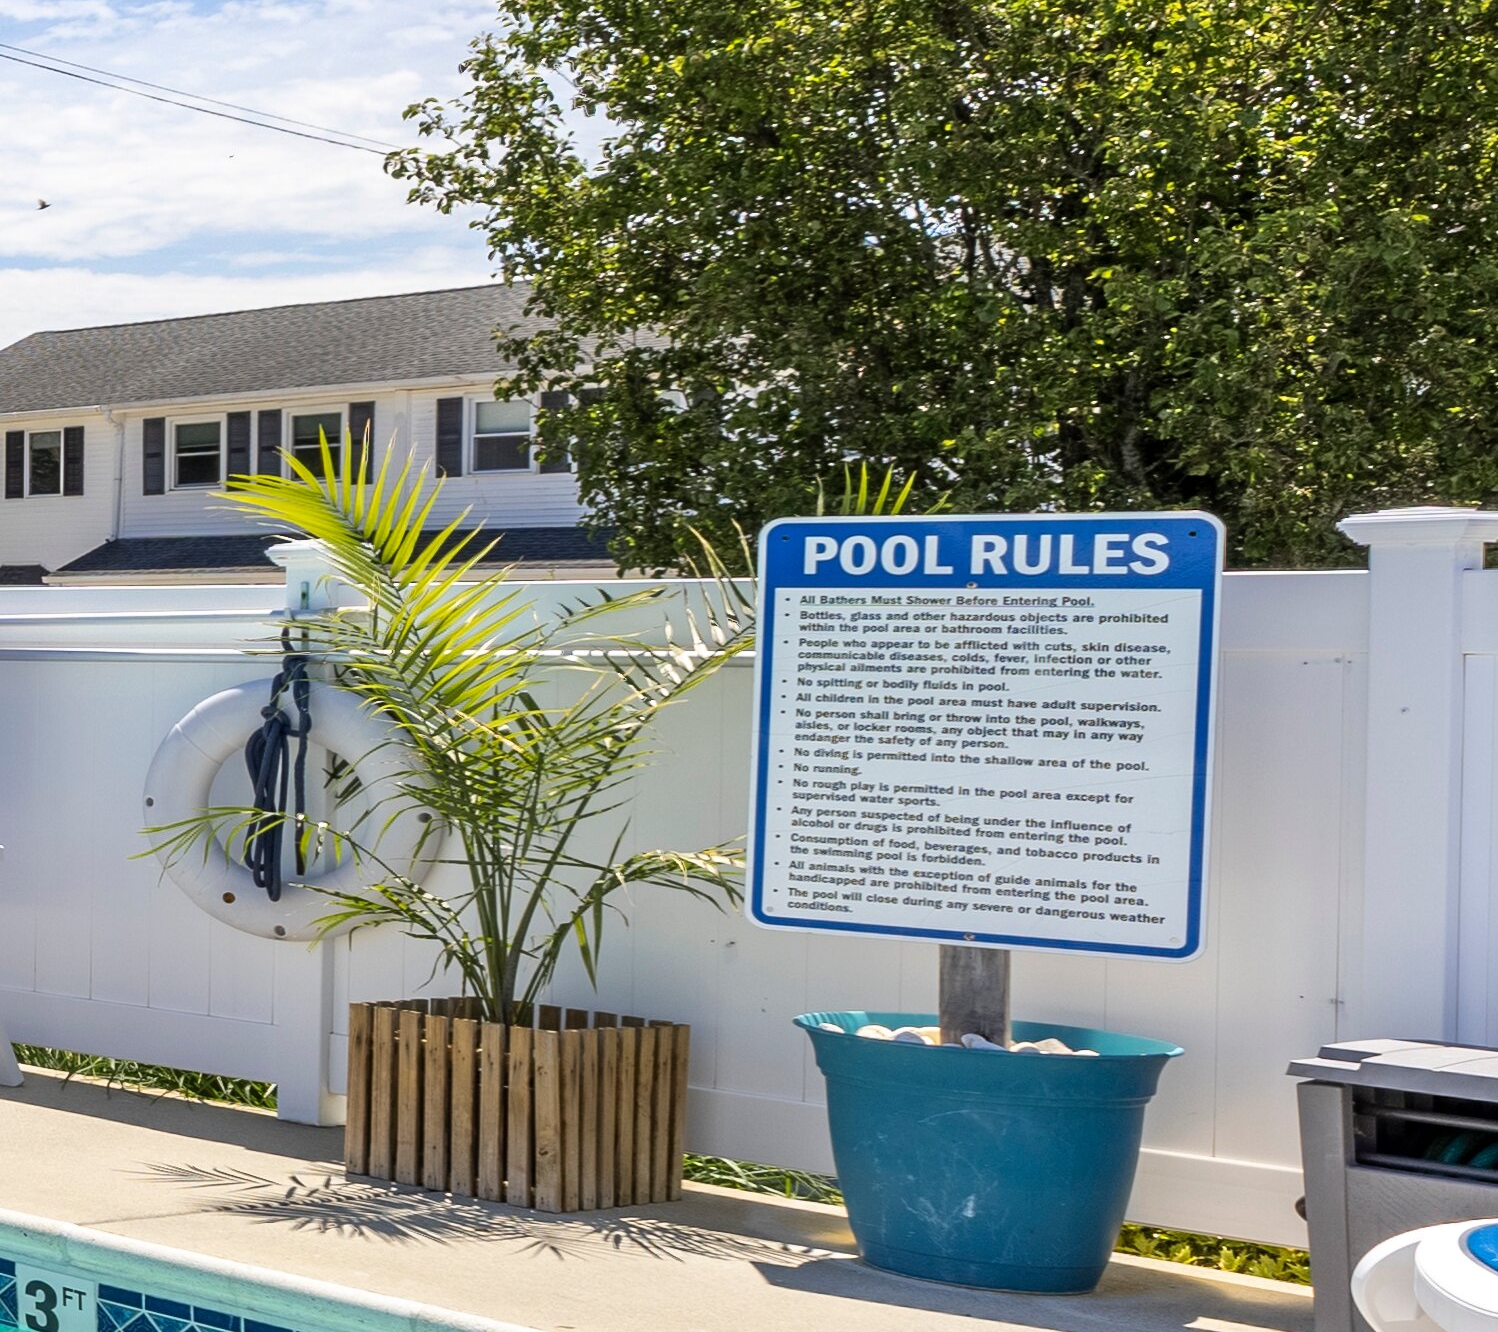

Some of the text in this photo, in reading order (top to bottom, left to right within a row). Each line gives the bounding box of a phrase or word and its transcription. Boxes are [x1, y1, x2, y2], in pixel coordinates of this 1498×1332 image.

[804, 533, 1169, 575] POOL RULES
[799, 595, 1094, 606] All Bathers Must Shower Before Entering Pool.
[800, 610, 846, 621] Bottles,
[850, 611, 882, 621] glass
[885, 611, 909, 620] and
[912, 612, 946, 621] other
[949, 612, 1016, 622] hazardous
[1019, 612, 1068, 623] objects
[1098, 613, 1168, 624] prohibited
[798, 622, 835, 631] within
[839, 623, 858, 632] the
[862, 623, 889, 633] pool
[892, 625, 920, 633] area
[941, 624, 1002, 634] bathroom
[1006, 624, 1068, 635] facilities.
[798, 638, 1171, 654] People who appear to be afflicted with cuts, skin disease,
[797, 651, 1152, 665] communicable diseases, colds, fever, infection or other
[797, 661, 846, 672] physical
[849, 663, 902, 673] ailments
[930, 664, 996, 675] prohibited
[1000, 665, 1030, 675] from
[1034, 667, 1090, 678] entering
[1094, 668, 1116, 677] the
[1120, 669, 1162, 678] water.
[797, 677, 813, 686] No
[816, 678, 862, 689] spitting
[882, 679, 919, 690] bodily
[922, 680, 958, 690] fluids
[962, 681, 974, 690] in
[978, 682, 1009, 692] pool.
[795, 692, 1161, 712] All children in the pool area must have adult supervision.
[795, 708, 811, 717] No
[815, 711, 856, 719] person
[859, 710, 889, 720] shall
[893, 711, 925, 723] bring
[945, 713, 982, 723] throw
[985, 714, 1011, 724] into
[1015, 715, 1036, 725] the
[1040, 716, 1073, 727] pool,
[1077, 717, 1145, 730] walkways,
[795, 720, 833, 731] aisles,
[853, 722, 891, 732] locker
[894, 725, 937, 734] rooms,
[941, 727, 963, 736] any
[966, 726, 1008, 737] object
[1011, 727, 1039, 737] that
[1042, 730, 1069, 739] may
[1073, 729, 1086, 739] in
[1090, 732, 1115, 741] any
[1117, 733, 1144, 742] way
[794, 732, 1009, 749] endanger the safety of any person.
[794, 747, 1149, 771] No diving is permitted into the shallow area of the pool.
[793, 763, 862, 776] No running.
[790, 805, 1131, 833] Any person suspected of being under the influence of
[791, 818, 834, 828] alcohol
[854, 821, 888, 833] drugs
[892, 823, 903, 832] is
[906, 825, 971, 836] prohibited
[975, 827, 1005, 838] from
[1009, 831, 1064, 843] entering
[1068, 833, 1090, 843] the
[1094, 836, 1127, 846] pool.
[788, 872, 1149, 906] handicapped are prohibited from entering the pool area.
[62, 1286, 87, 1311] FT
